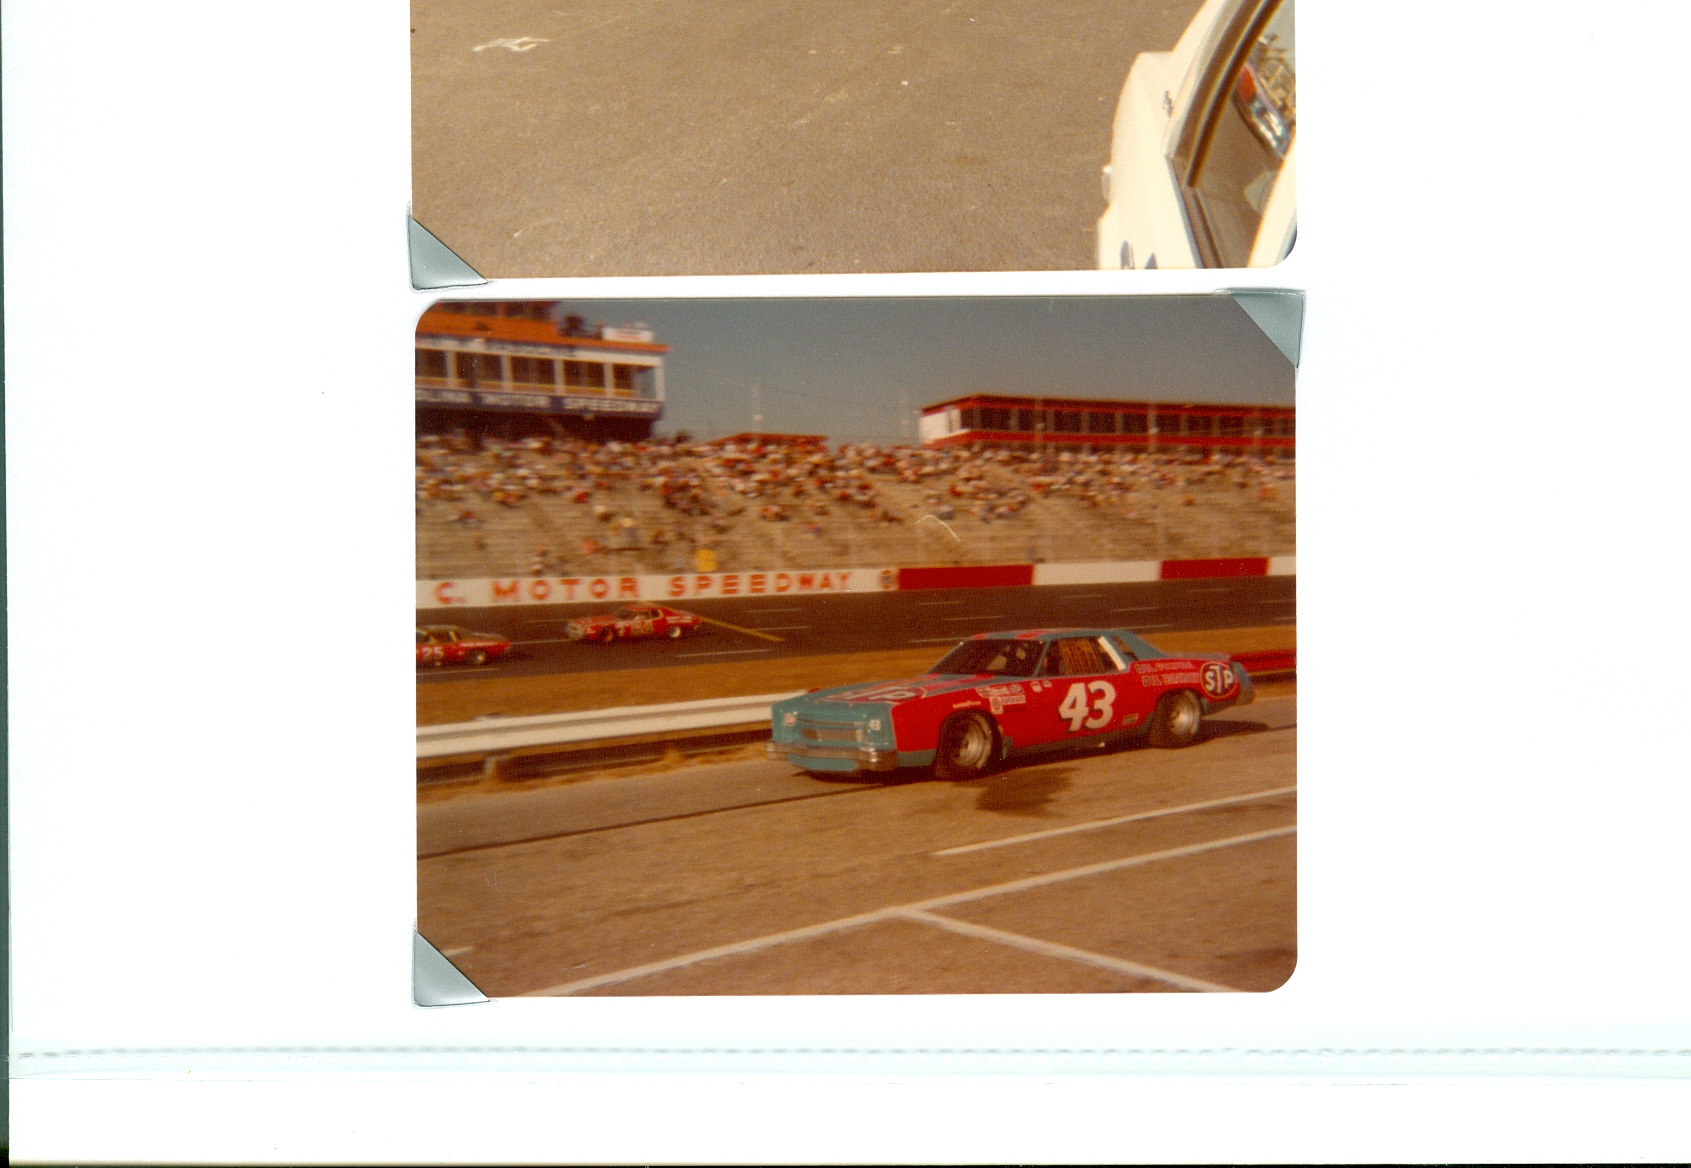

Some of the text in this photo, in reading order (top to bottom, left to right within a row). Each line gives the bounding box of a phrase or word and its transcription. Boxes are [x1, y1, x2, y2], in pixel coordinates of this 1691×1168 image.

[491, 577, 641, 602] MOTOR
[668, 572, 851, 597] SPEEDWAY
[1204, 665, 1235, 694] STP
[1058, 680, 1116, 732] 43
